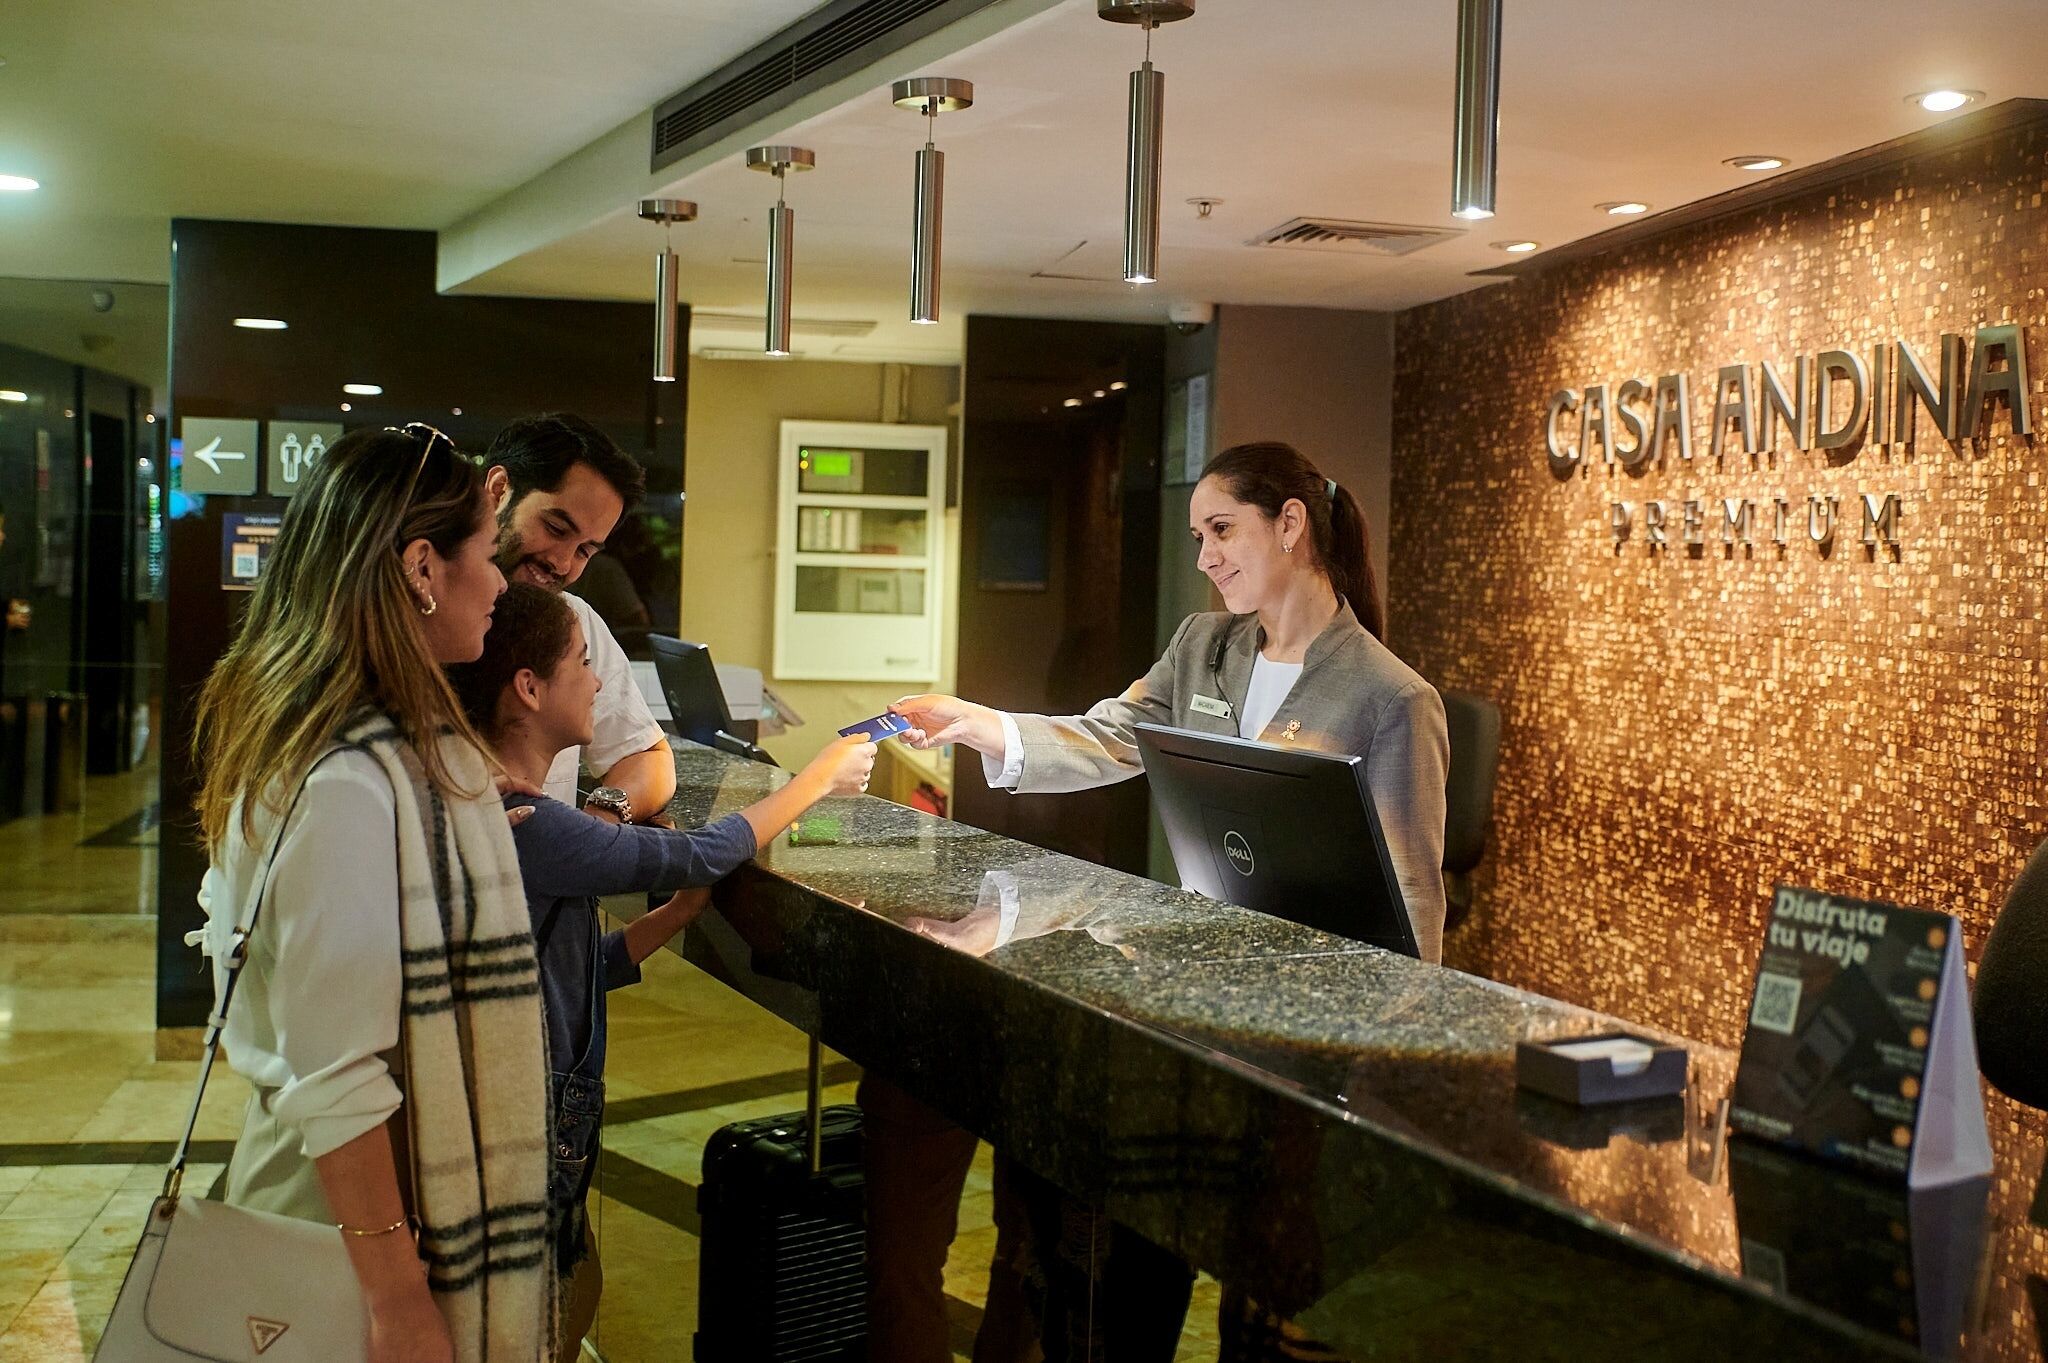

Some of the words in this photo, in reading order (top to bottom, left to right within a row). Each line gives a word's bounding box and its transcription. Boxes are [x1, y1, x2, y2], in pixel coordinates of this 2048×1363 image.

[1547, 373, 1692, 466] CASA
[1711, 324, 2032, 456] ANDINA
[1611, 494, 1901, 546] PREMIUM
[1227, 846, 1251, 861] DELL
[1775, 889, 1887, 937] Disfruta
[1770, 921, 1796, 950] tu
[1802, 929, 1870, 969] viaje
